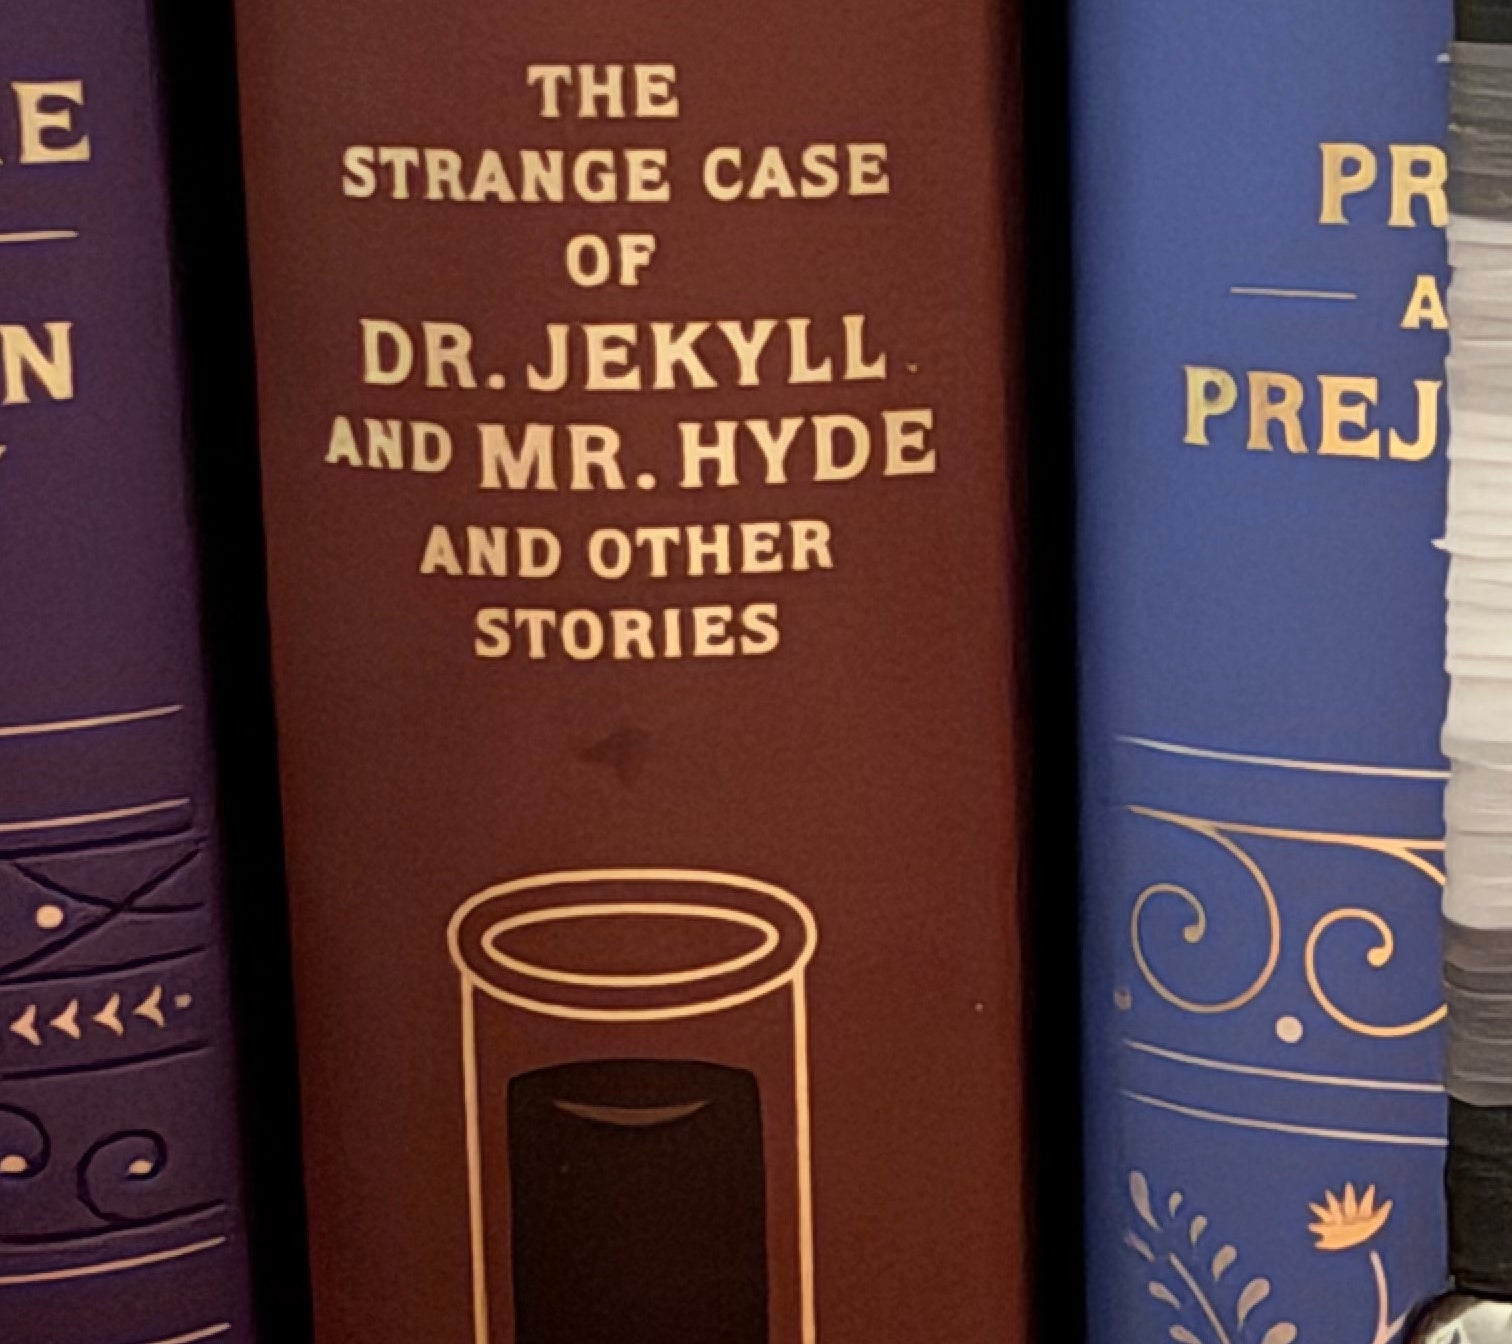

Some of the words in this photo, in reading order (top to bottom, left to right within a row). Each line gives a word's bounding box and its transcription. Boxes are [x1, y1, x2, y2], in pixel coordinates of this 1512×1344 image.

[527, 64, 679, 118] THE
[0, 80, 91, 165] E
[342, 146, 670, 202] STRANGE
[703, 143, 890, 202] CASE
[566, 234, 656, 287] OF
[360, 318, 506, 390] DR.
[526, 314, 886, 392] JEKYLL
[324, 416, 452, 472] AND
[478, 423, 656, 490] MR.
[678, 408, 936, 488] HYDE
[420, 525, 562, 578] AND
[588, 520, 833, 579] OTHER
[475, 602, 780, 660] STORIES
